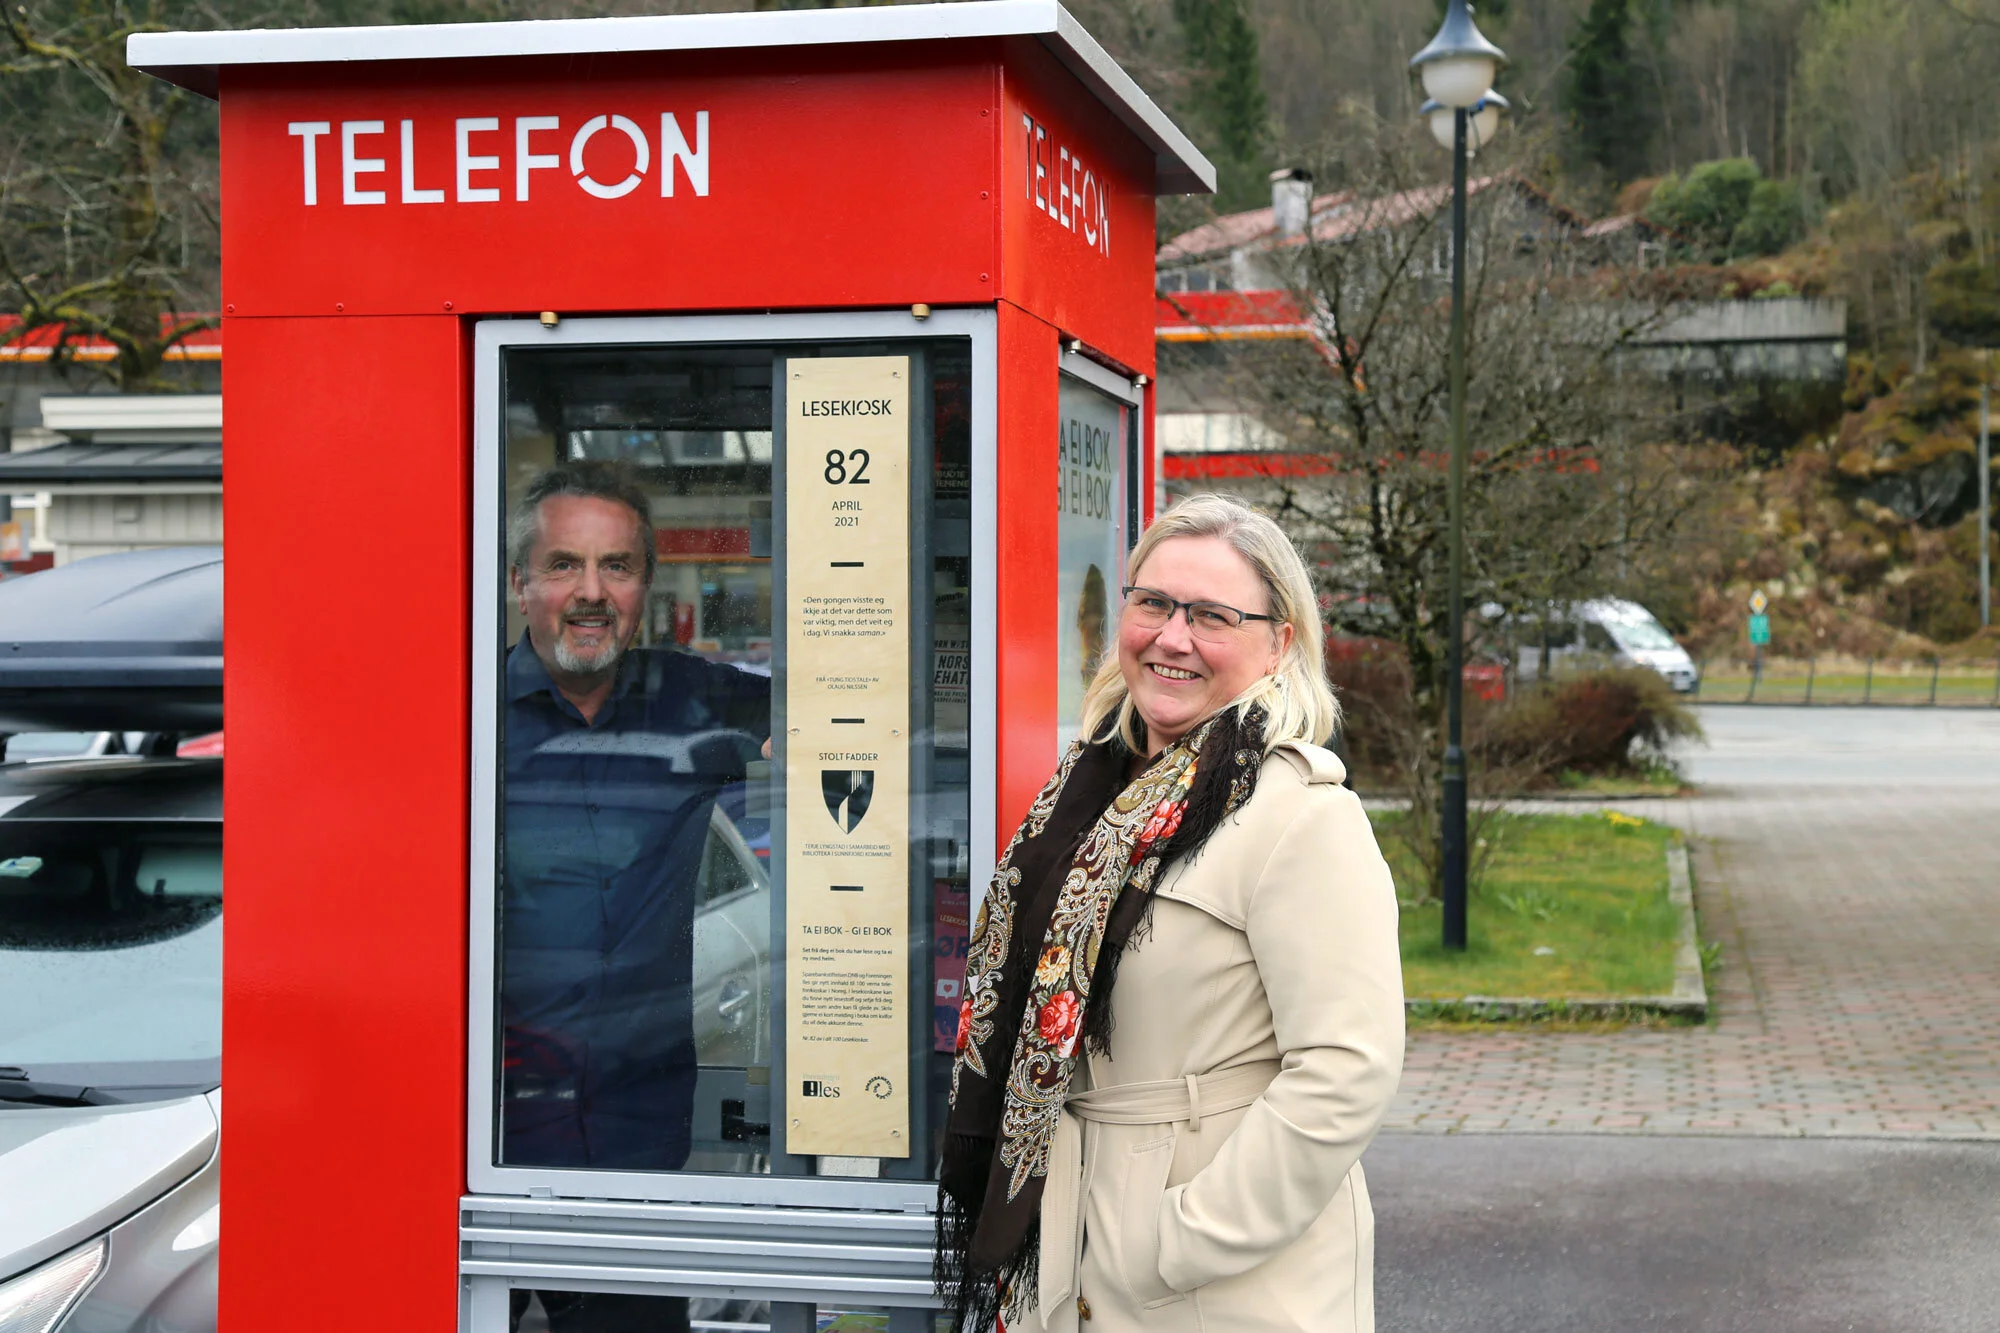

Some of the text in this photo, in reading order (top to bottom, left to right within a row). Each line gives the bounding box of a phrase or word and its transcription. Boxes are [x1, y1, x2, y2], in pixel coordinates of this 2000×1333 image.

[287, 110, 710, 206] TELEFON
[1022, 112, 1110, 258] TELEFON
[802, 400, 892, 416] LESEKIOSK
[1071, 419, 1082, 466] EI
[1086, 424, 1112, 474] BOK
[824, 448, 870, 485] 82
[1071, 469, 1082, 516] EI
[1086, 474, 1112, 521] BOK
[832, 500, 862, 512] APRIL
[834, 516, 860, 527] 2021
[803, 608, 820, 616] ikkje
[819, 752, 879, 761] STOLT FADDER
[802, 925, 812, 934] TA
[814, 926, 822, 934] EI
[824, 926, 843, 935] BOK
[851, 926, 861, 935] GI
[863, 927, 871, 935] EI
[873, 927, 892, 936] BOK
